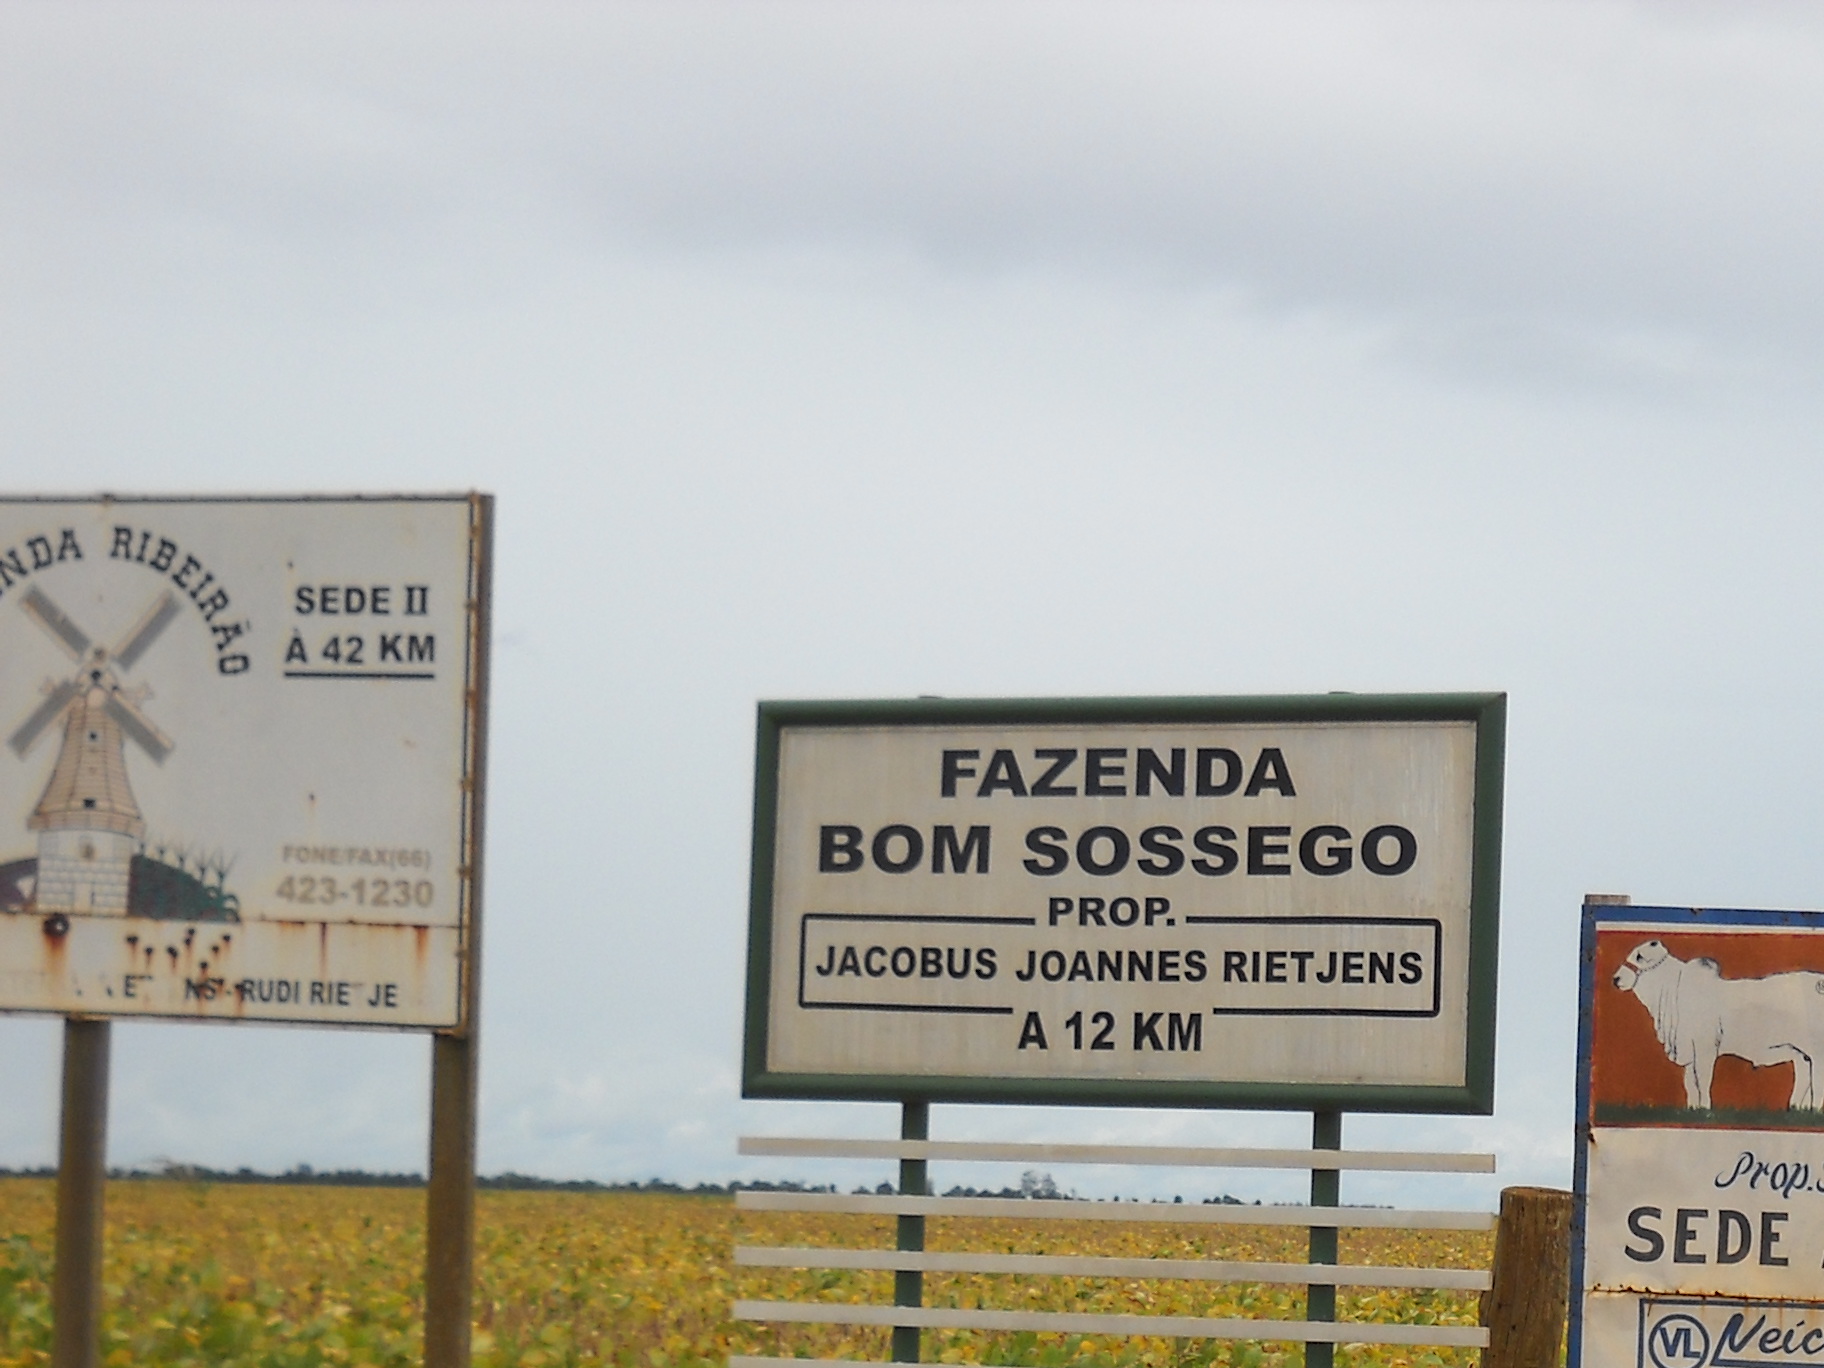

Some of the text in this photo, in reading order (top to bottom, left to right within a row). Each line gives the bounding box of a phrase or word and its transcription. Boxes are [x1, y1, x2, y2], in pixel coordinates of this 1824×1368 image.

[0, 526, 252, 675] NDA RIBEIRÃO
[295, 585, 428, 615] SEDE II
[322, 636, 364, 664] 42
[380, 634, 435, 662] KM
[940, 747, 1297, 798] FAZENDA
[818, 824, 1418, 877] BOM SOSSEGO
[276, 876, 434, 908] 423-1230
[1048, 897, 1177, 927] PROP.
[815, 946, 1424, 986] JACOBUS JOANNES RIETJENS
[1018, 1011, 1203, 1053] A 12 KM
[1715, 1152, 1812, 1198] Prop.
[1624, 1207, 1789, 1267] SEDE
[1660, 1327, 1702, 1359] VL
